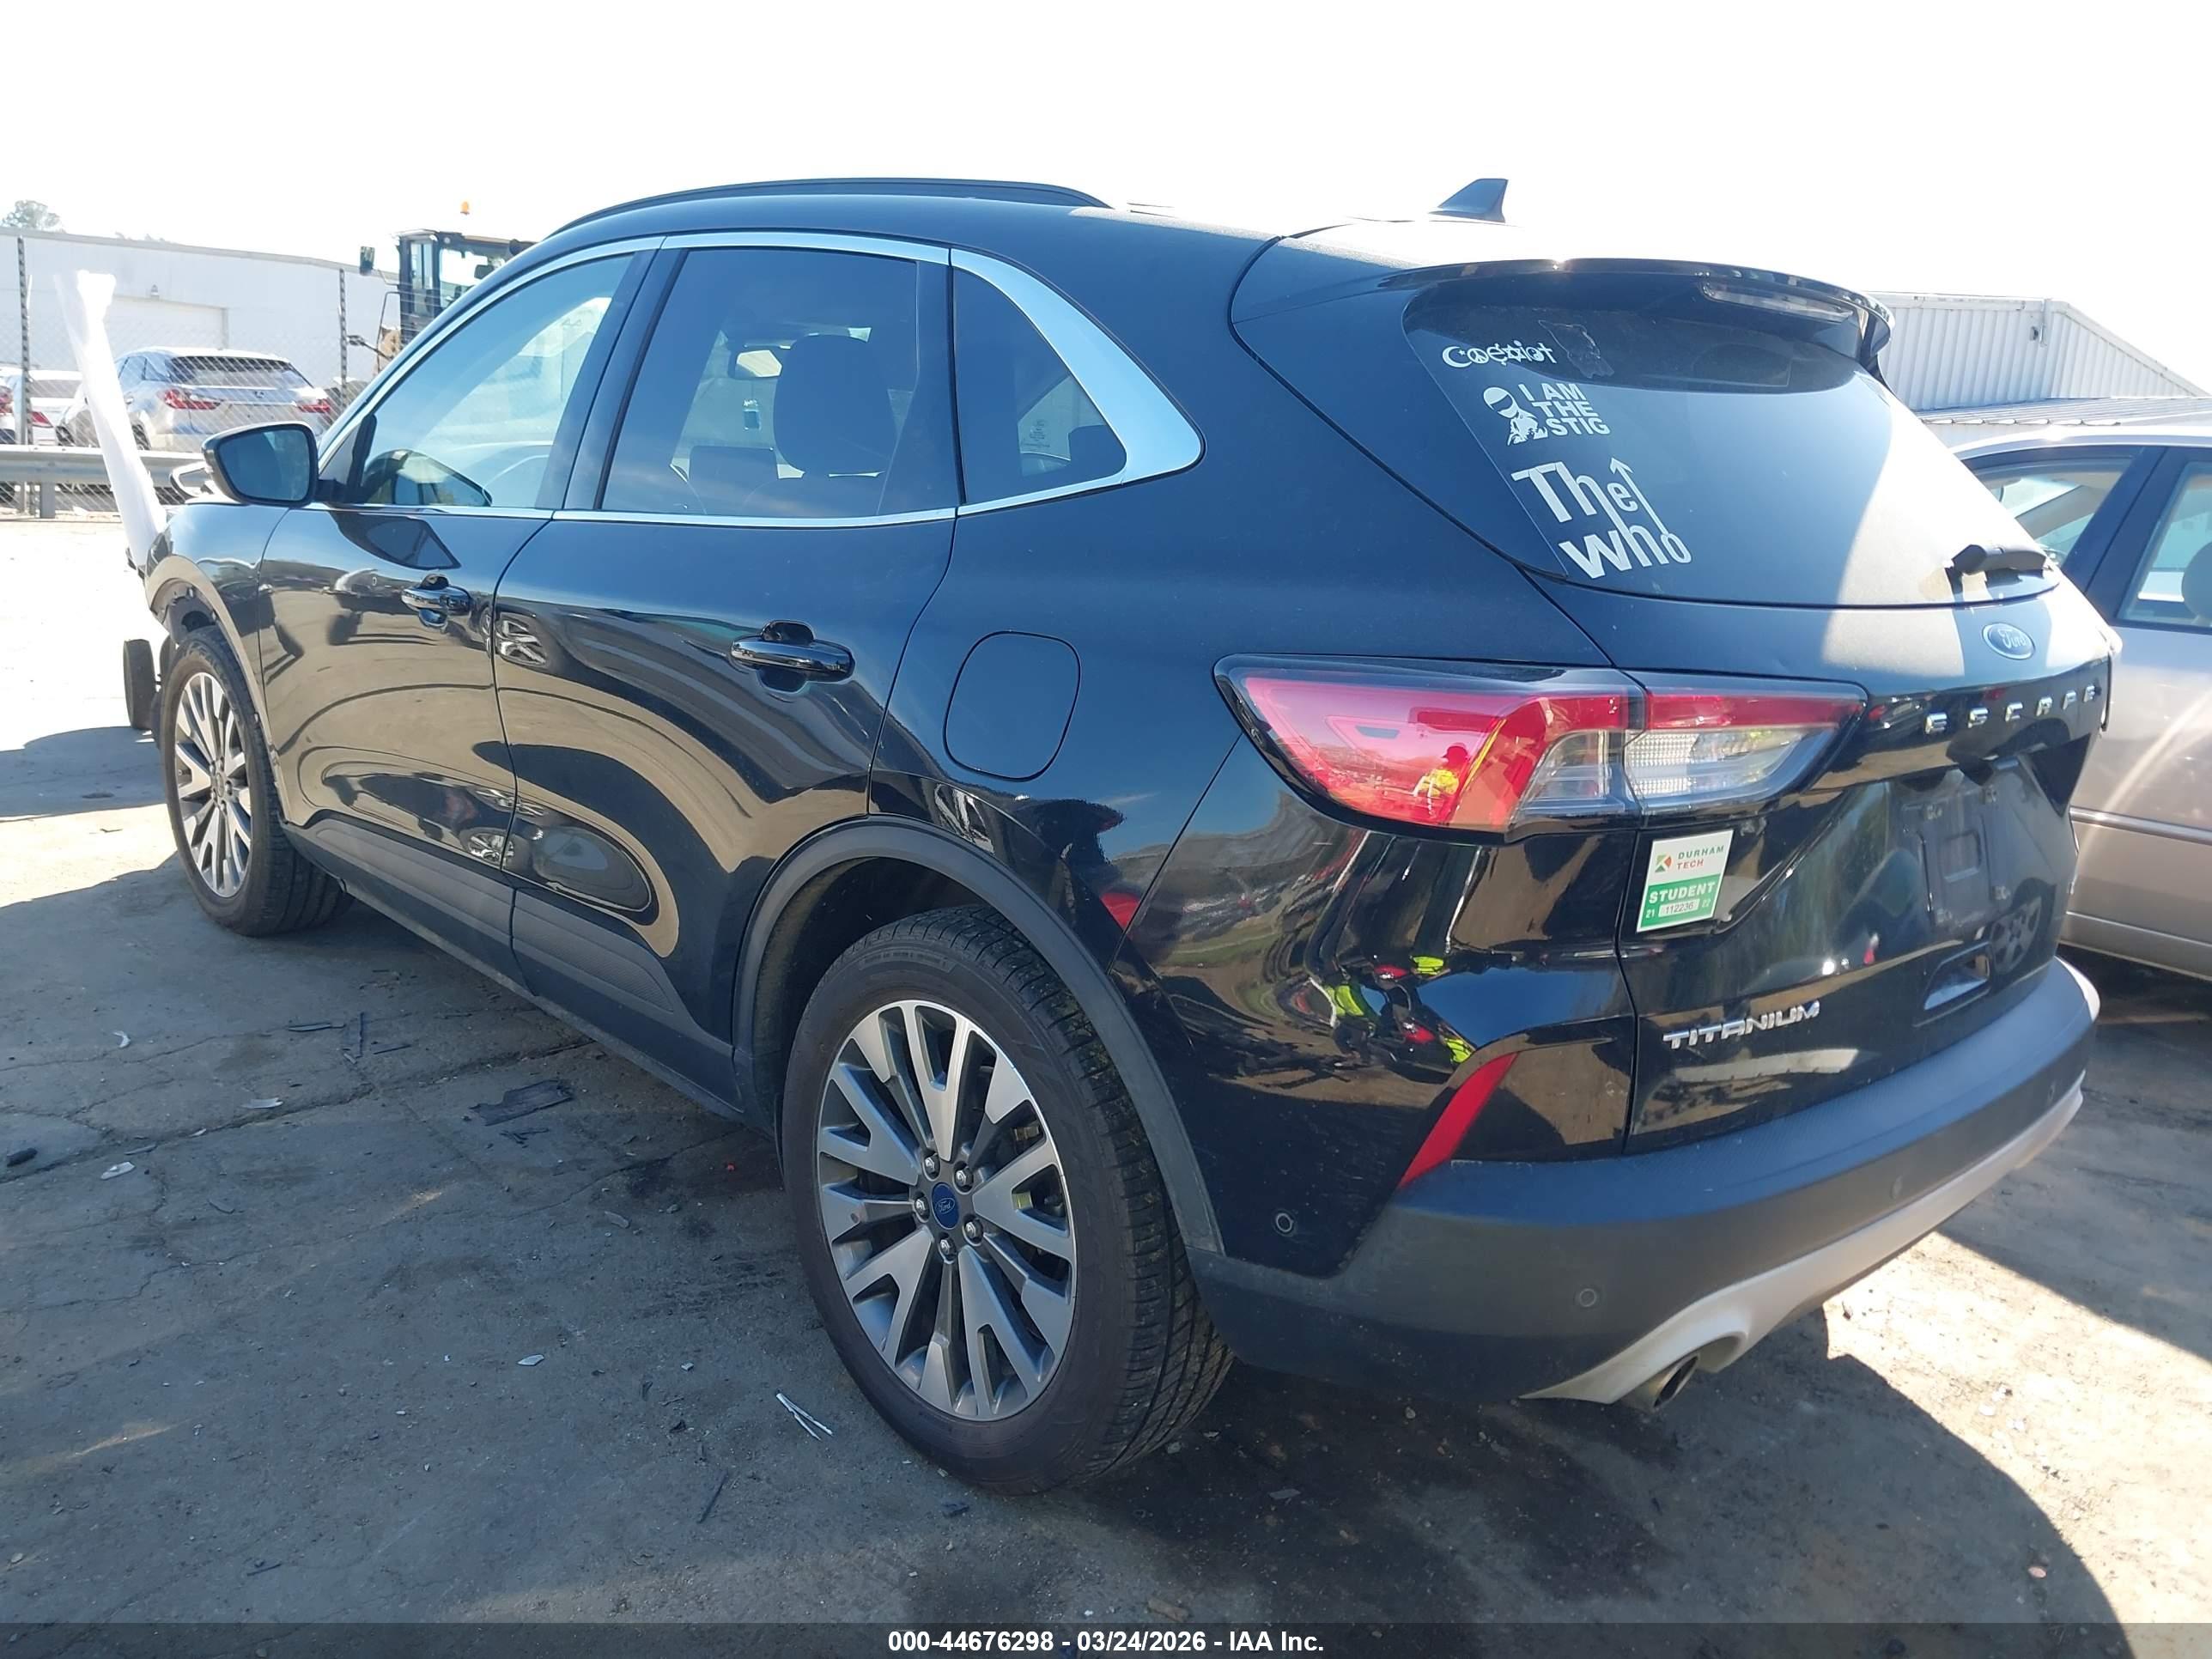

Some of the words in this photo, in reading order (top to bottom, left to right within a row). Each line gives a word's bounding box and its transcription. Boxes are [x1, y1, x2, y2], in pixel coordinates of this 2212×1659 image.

[1517, 383, 1534, 402] I
[1541, 383, 1587, 401] AM
[1531, 400, 1599, 418] THE
[1546, 417, 1611, 436] STIG
[1511, 460, 1639, 523] The
[1924, 684, 2096, 736] ESCAPE
[1678, 845, 1724, 860] DURHAM
[1676, 859, 1704, 870] TECH
[1648, 881, 1716, 904] STUDENT
[1662, 1000, 1820, 1049] TITANIUM
